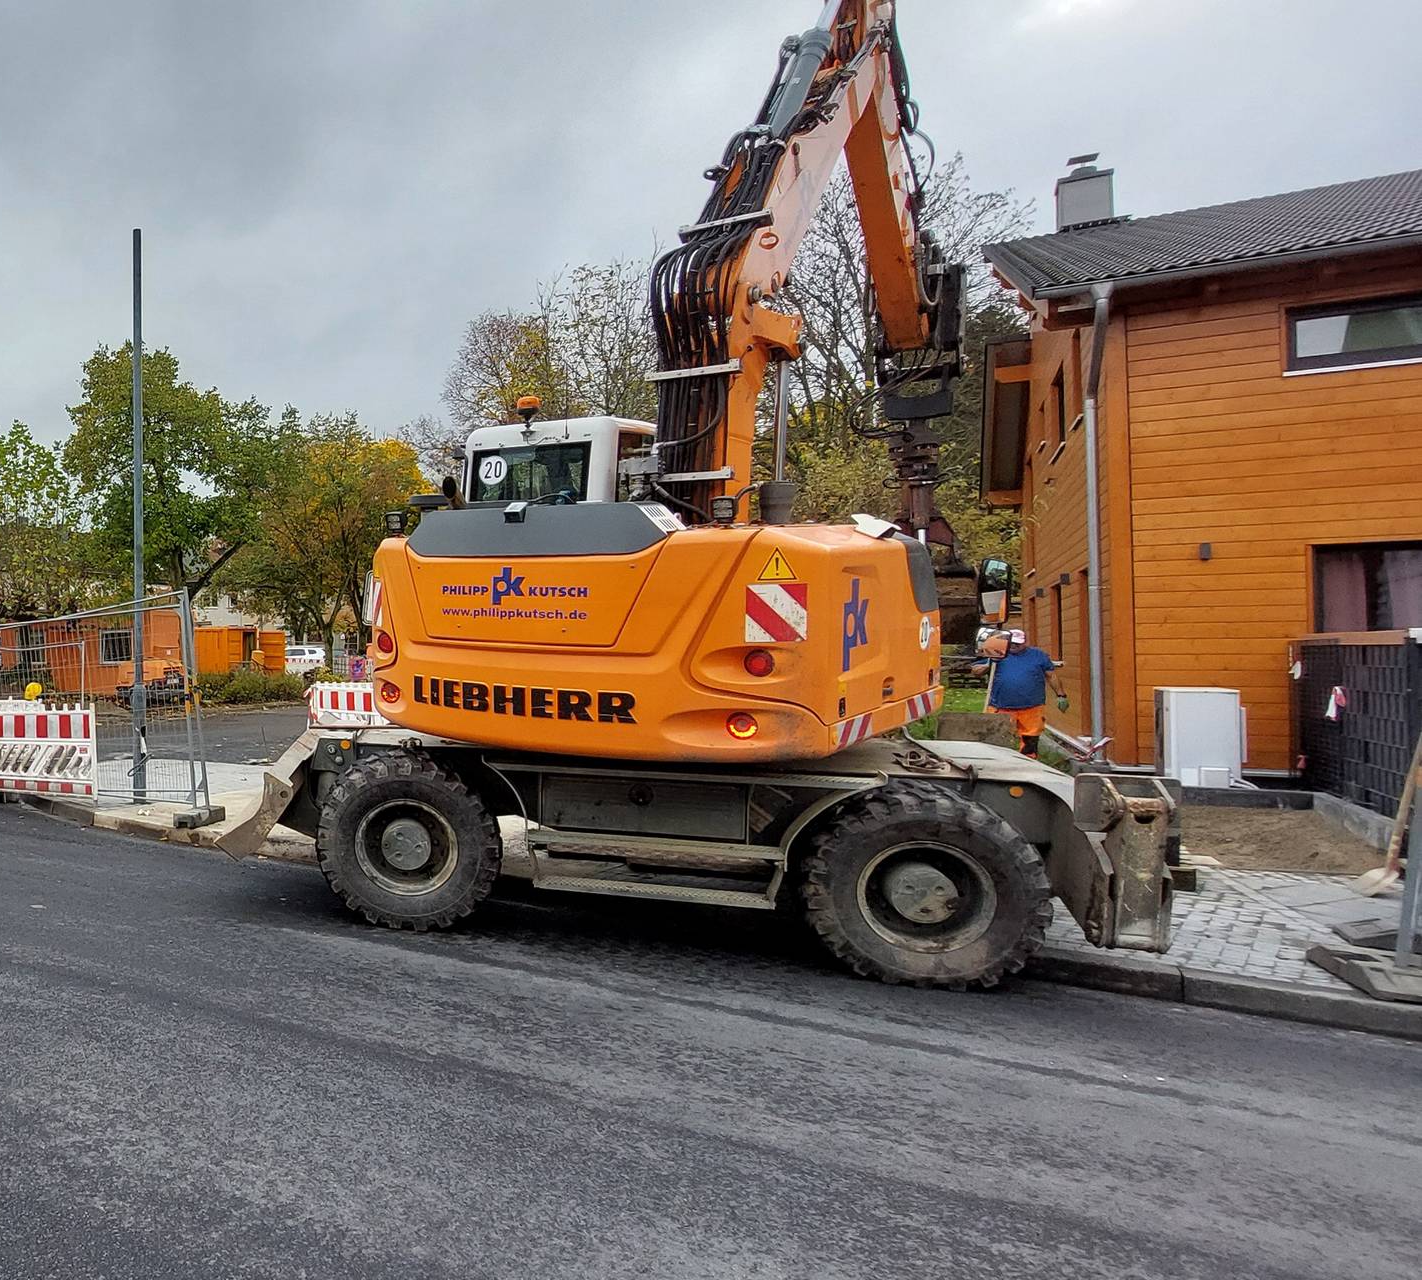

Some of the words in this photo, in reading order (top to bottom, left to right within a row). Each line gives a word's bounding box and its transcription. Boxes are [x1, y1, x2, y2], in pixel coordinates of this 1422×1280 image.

[484, 460, 502, 479] 20
[442, 585, 489, 596] PHILIPP
[529, 586, 588, 598] KUTSCH
[442, 607, 588, 620] www.philippkutsch.de
[920, 621, 929, 643] 20
[413, 674, 639, 724] LIEBHERR
